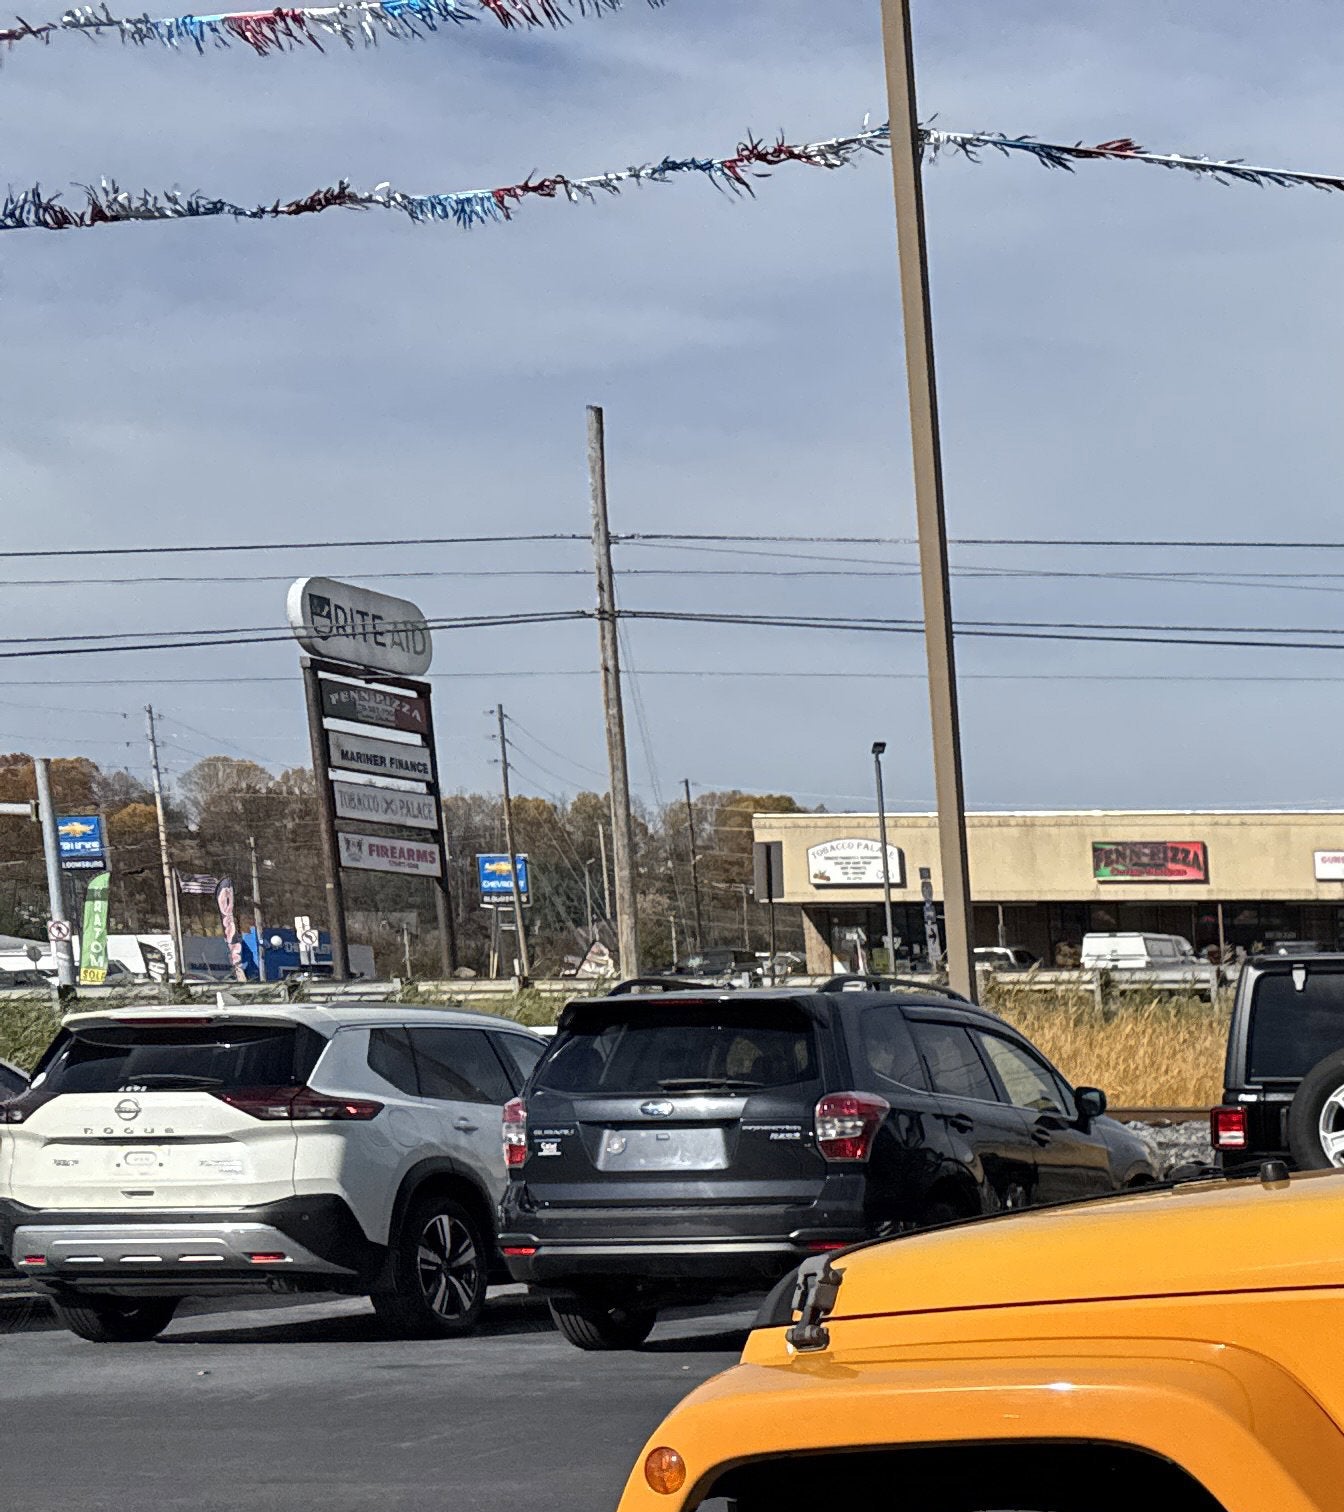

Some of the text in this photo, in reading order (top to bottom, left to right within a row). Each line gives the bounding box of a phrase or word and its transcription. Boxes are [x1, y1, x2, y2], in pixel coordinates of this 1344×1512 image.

[334, 604, 427, 656] RITE AID
[340, 749, 429, 774] MARINER FINANCE
[338, 790, 434, 821] TOBACCO PALACE
[368, 843, 437, 865] FIREARMS
[811, 841, 895, 860] TOBACCO PALAE
[83, 1127, 175, 1135] ROGUE
